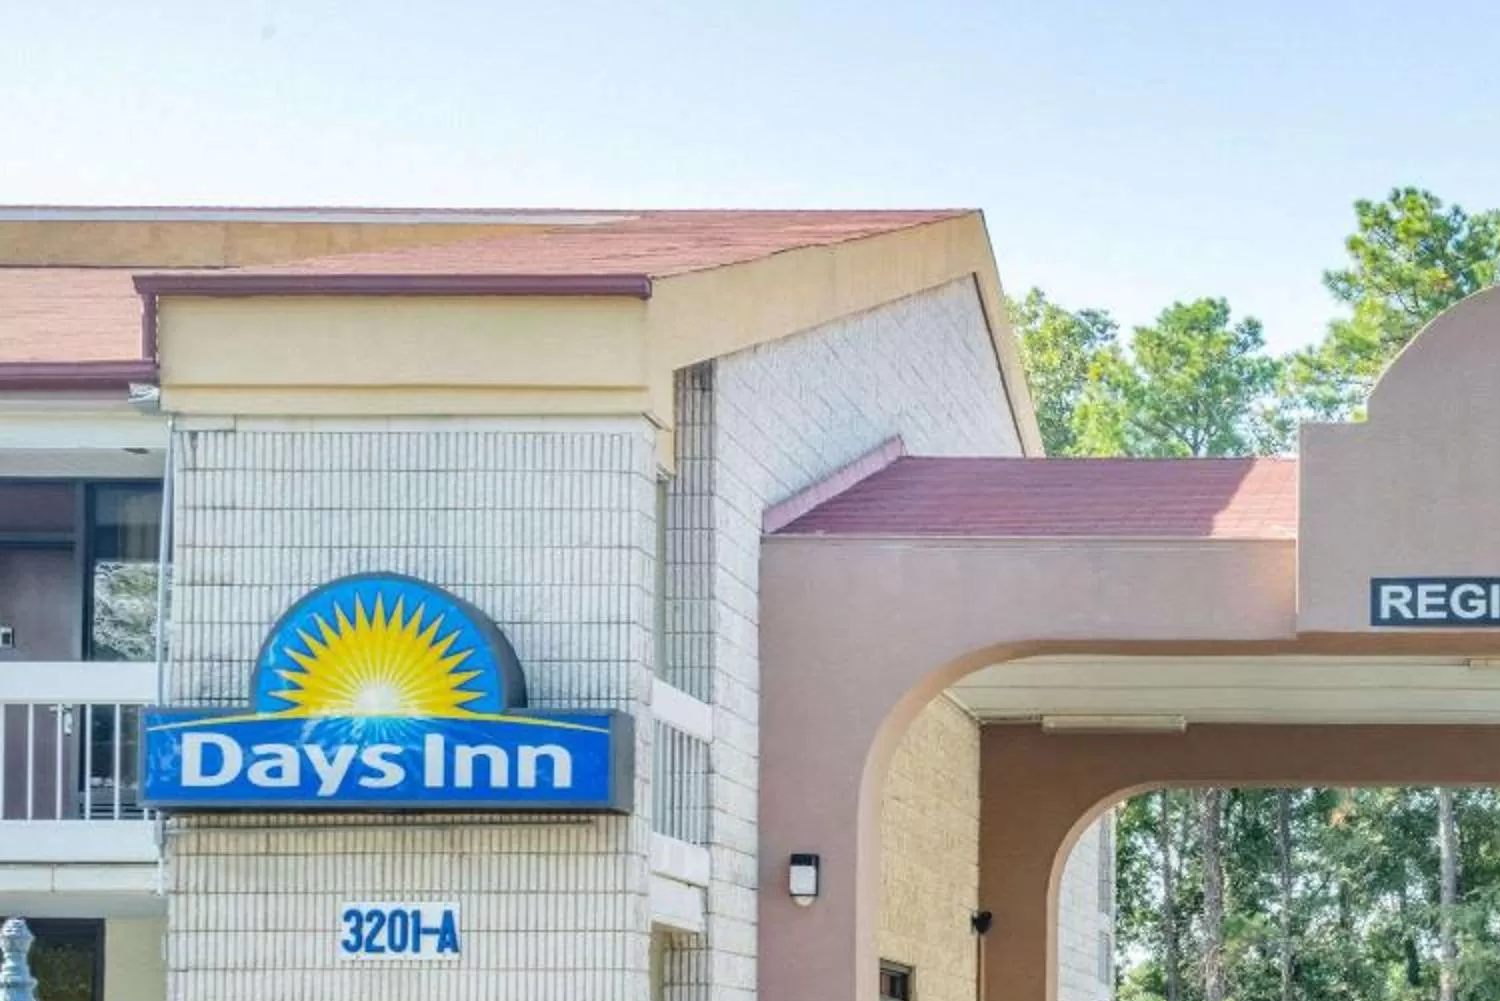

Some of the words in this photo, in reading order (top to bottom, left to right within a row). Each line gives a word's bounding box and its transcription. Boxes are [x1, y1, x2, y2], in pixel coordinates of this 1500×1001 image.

[180, 732, 403, 796] Days
[423, 733, 572, 788] Inn
[341, 908, 460, 953] 3201-A
